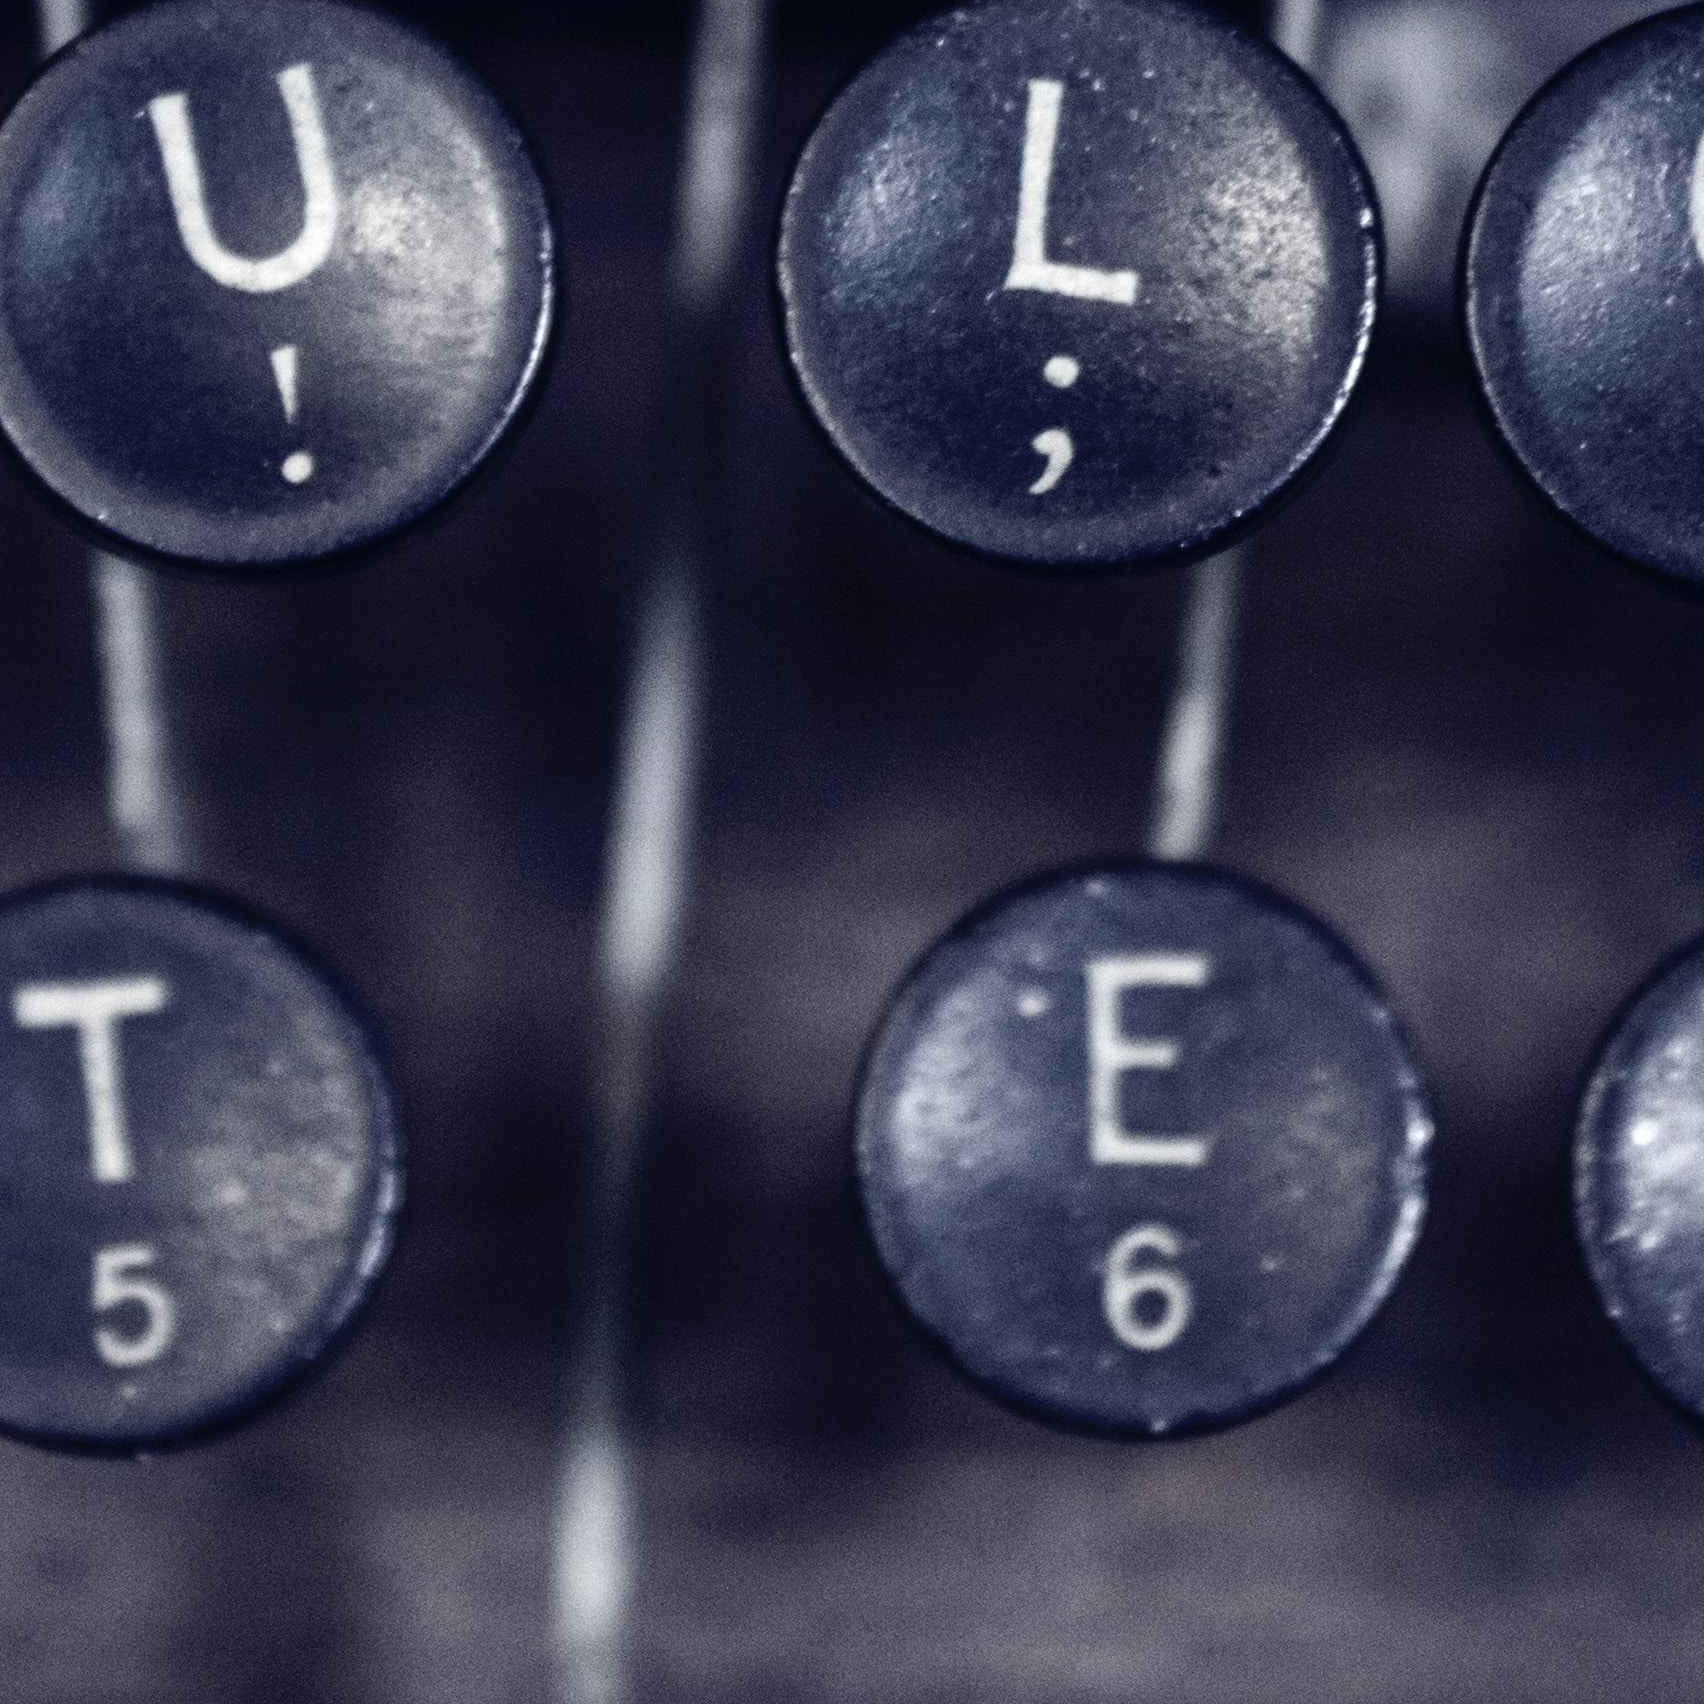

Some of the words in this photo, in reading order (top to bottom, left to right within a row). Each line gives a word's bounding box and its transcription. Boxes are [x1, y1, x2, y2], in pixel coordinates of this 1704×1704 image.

[148, 63, 338, 294] U
[1002, 77, 1139, 305] L
[269, 343, 316, 485] !
[1026, 352, 1081, 497] ;
[13, 975, 168, 1183] T
[1083, 952, 1212, 1166] E
[91, 1246, 175, 1368] 5
[1099, 1223, 1192, 1351] 6
